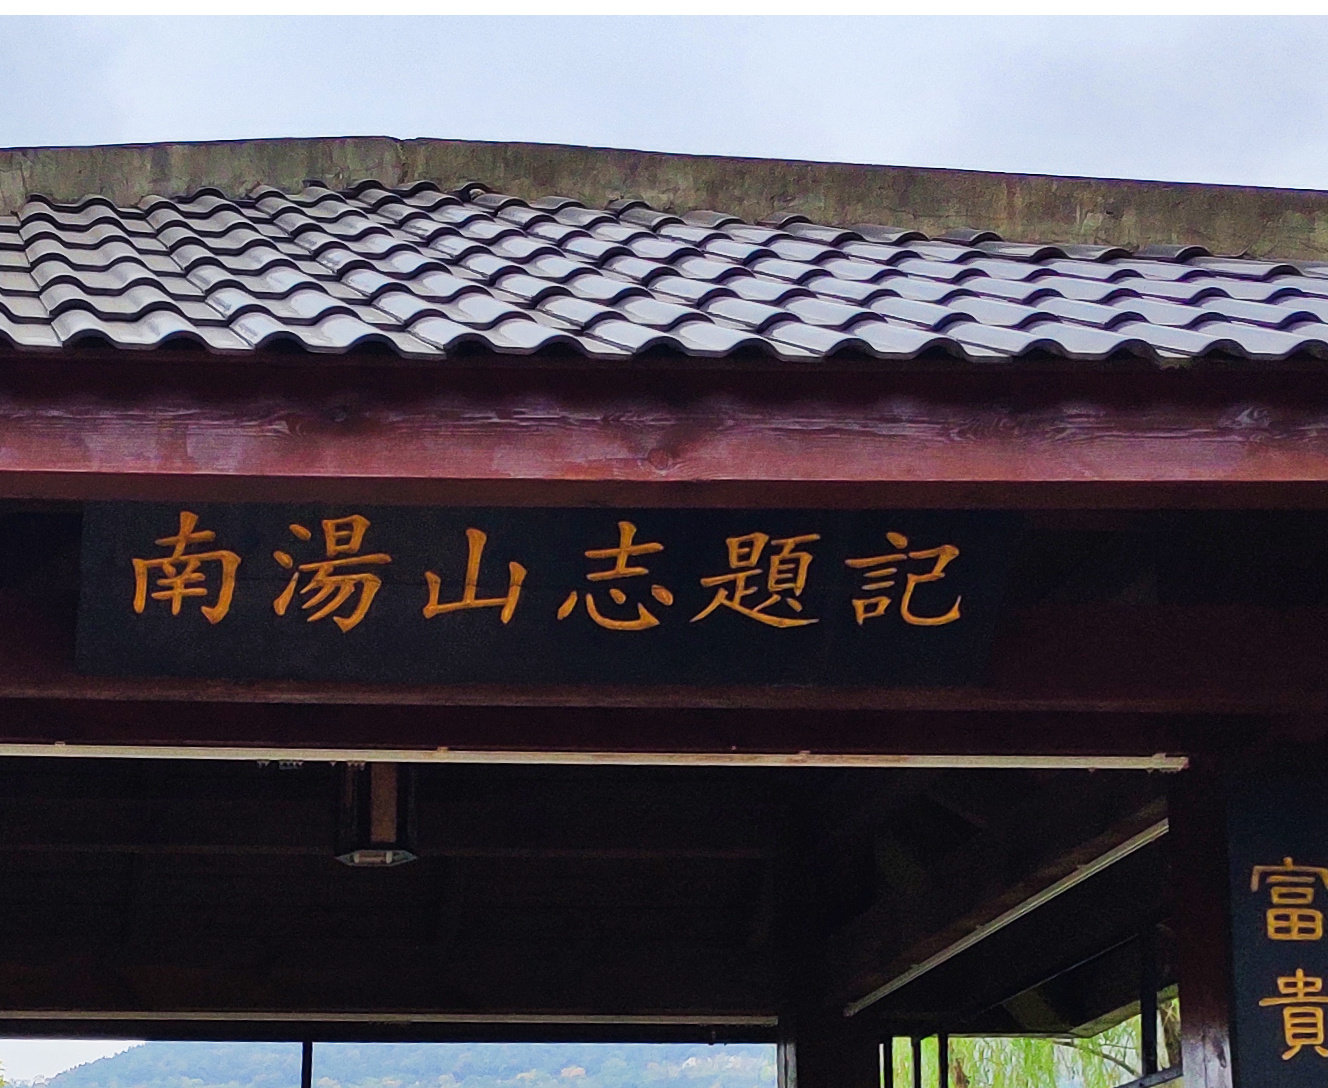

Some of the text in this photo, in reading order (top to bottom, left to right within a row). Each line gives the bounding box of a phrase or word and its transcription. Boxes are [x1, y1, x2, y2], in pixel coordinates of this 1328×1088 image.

[131, 510, 962, 633] 南湯山志題記
